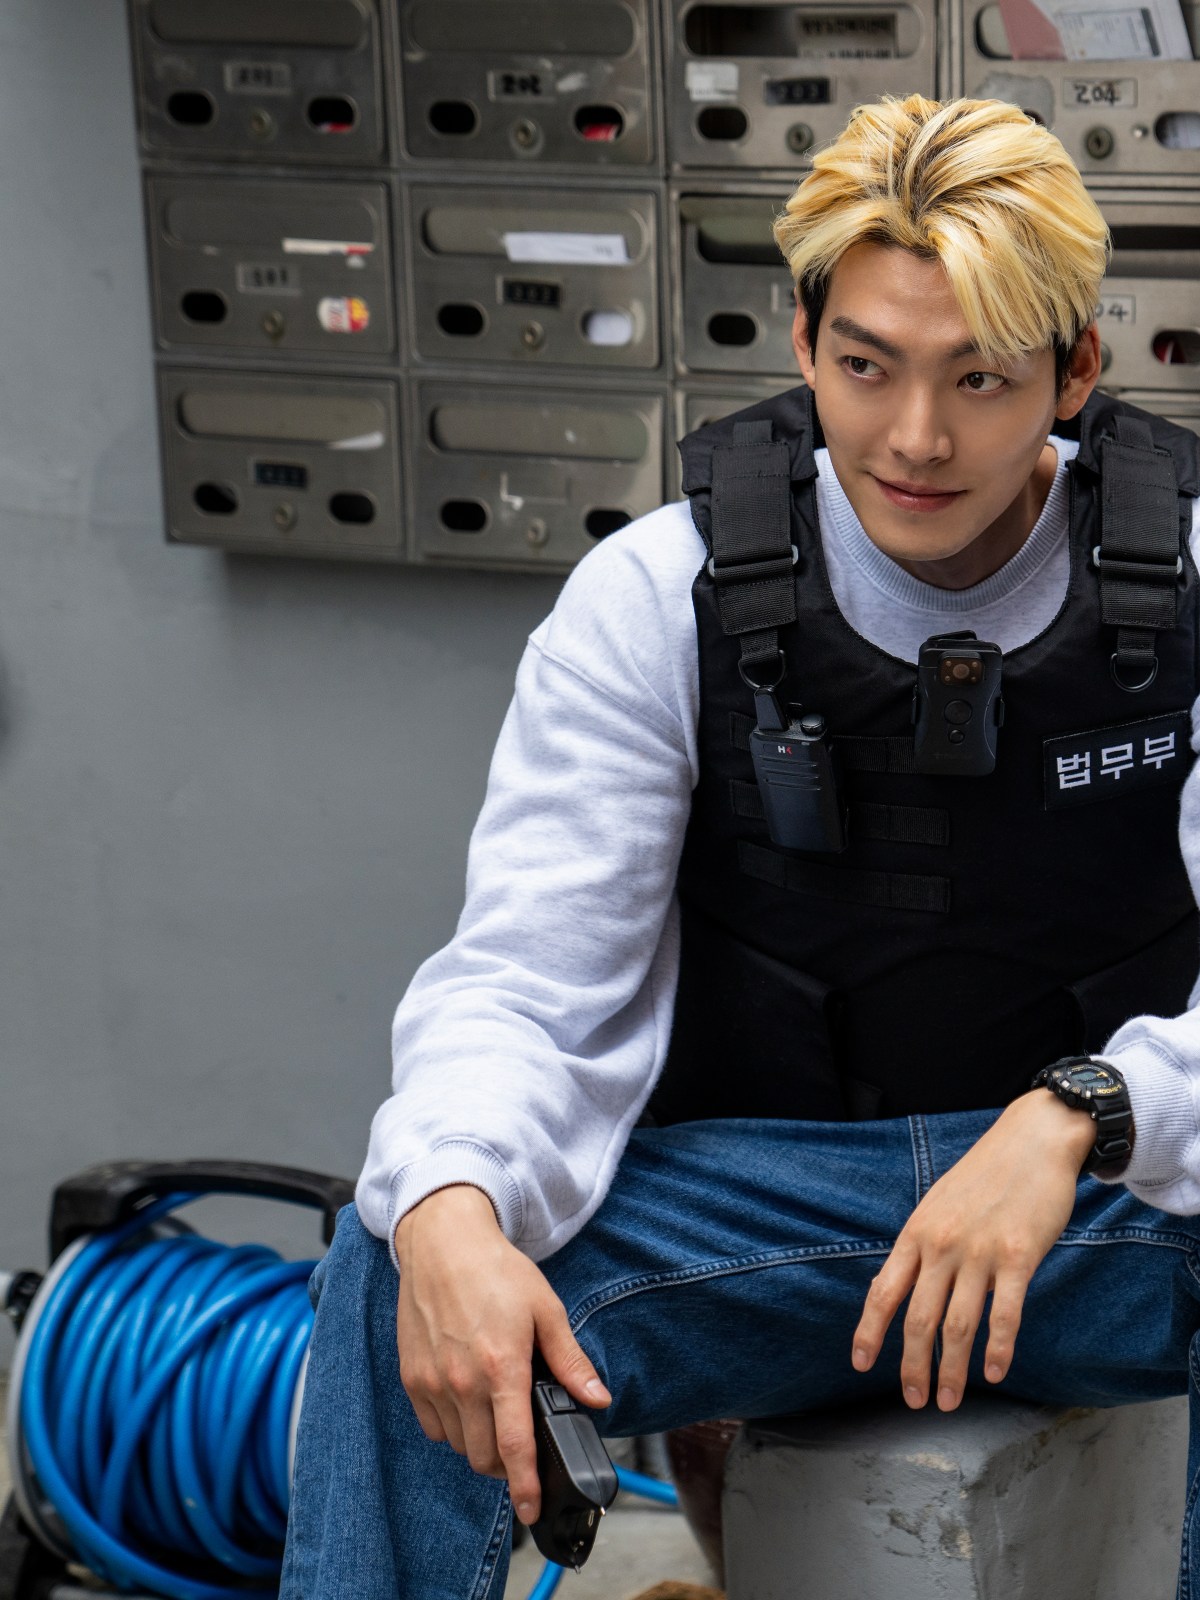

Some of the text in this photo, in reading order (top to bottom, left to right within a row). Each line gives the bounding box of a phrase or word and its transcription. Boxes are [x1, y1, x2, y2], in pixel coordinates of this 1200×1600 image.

[1073, 82, 1120, 105] 204
[1095, 302, 1129, 322] 04
[1056, 731, 1176, 790] 법무부
